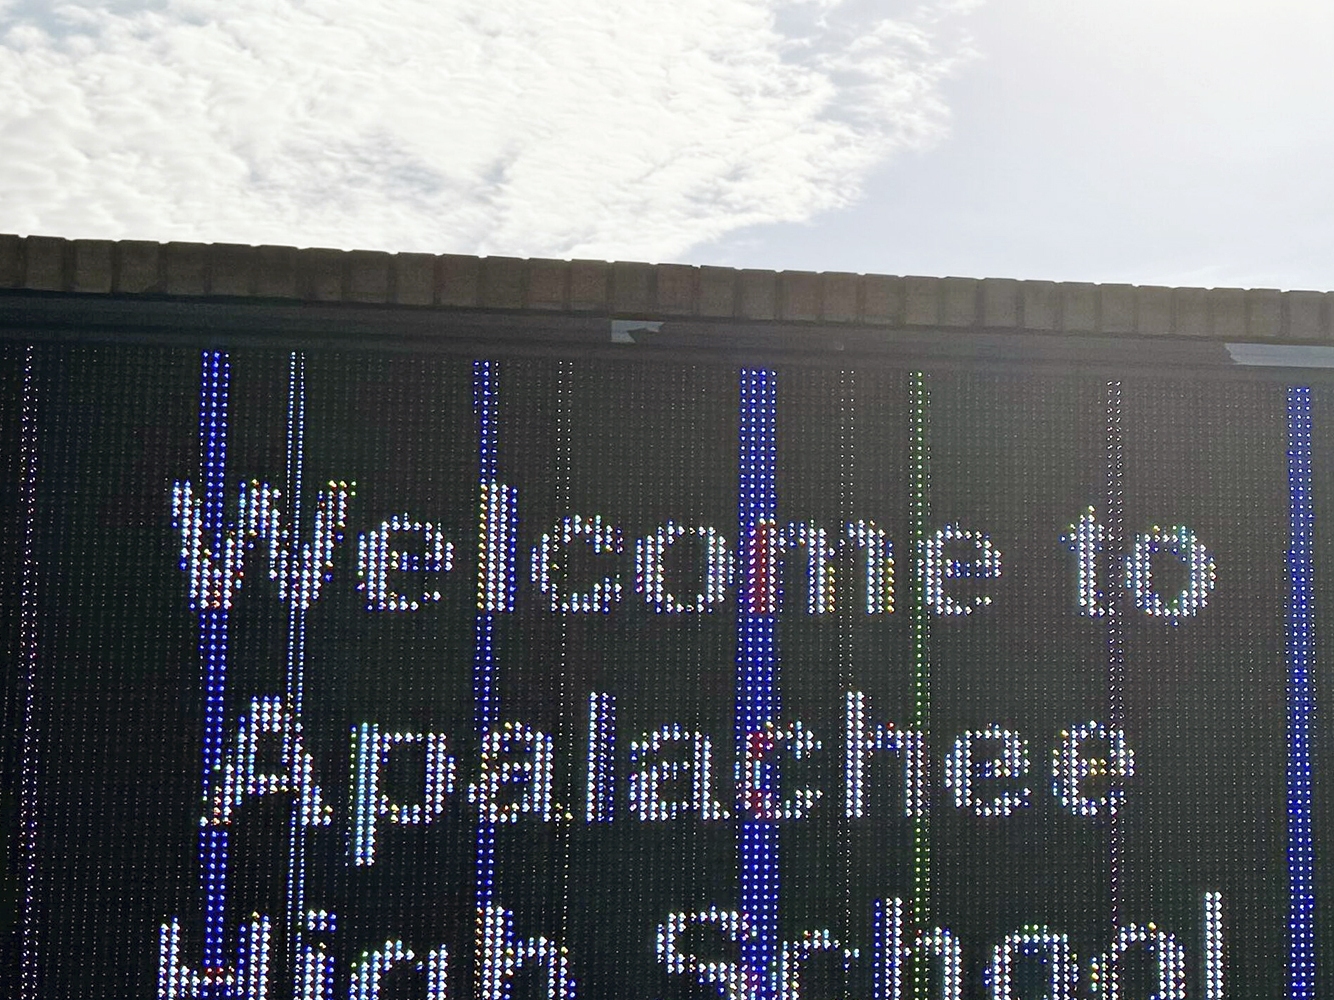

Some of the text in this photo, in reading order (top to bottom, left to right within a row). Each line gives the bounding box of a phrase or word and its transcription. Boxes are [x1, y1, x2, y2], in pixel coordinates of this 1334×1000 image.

[172, 479, 1216, 623] Welcome to
[199, 691, 1135, 866] Apalachee
